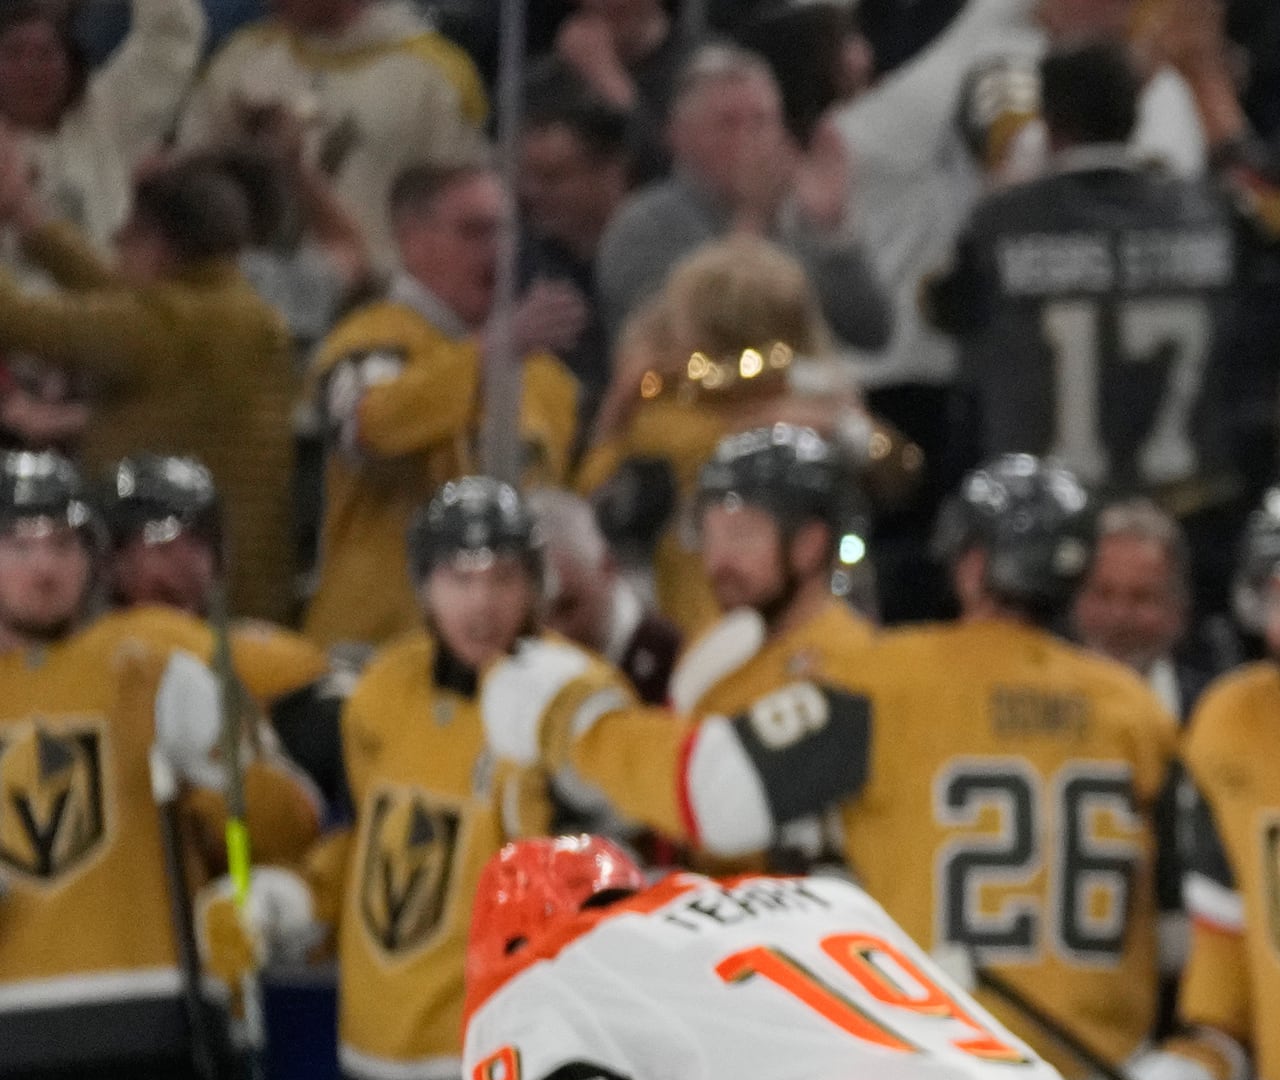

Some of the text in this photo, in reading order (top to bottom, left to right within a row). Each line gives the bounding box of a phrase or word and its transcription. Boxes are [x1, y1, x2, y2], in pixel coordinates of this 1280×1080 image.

[1042, 300, 1211, 484] 17
[932, 755, 1144, 967] 26
[713, 931, 1038, 1066] 19
